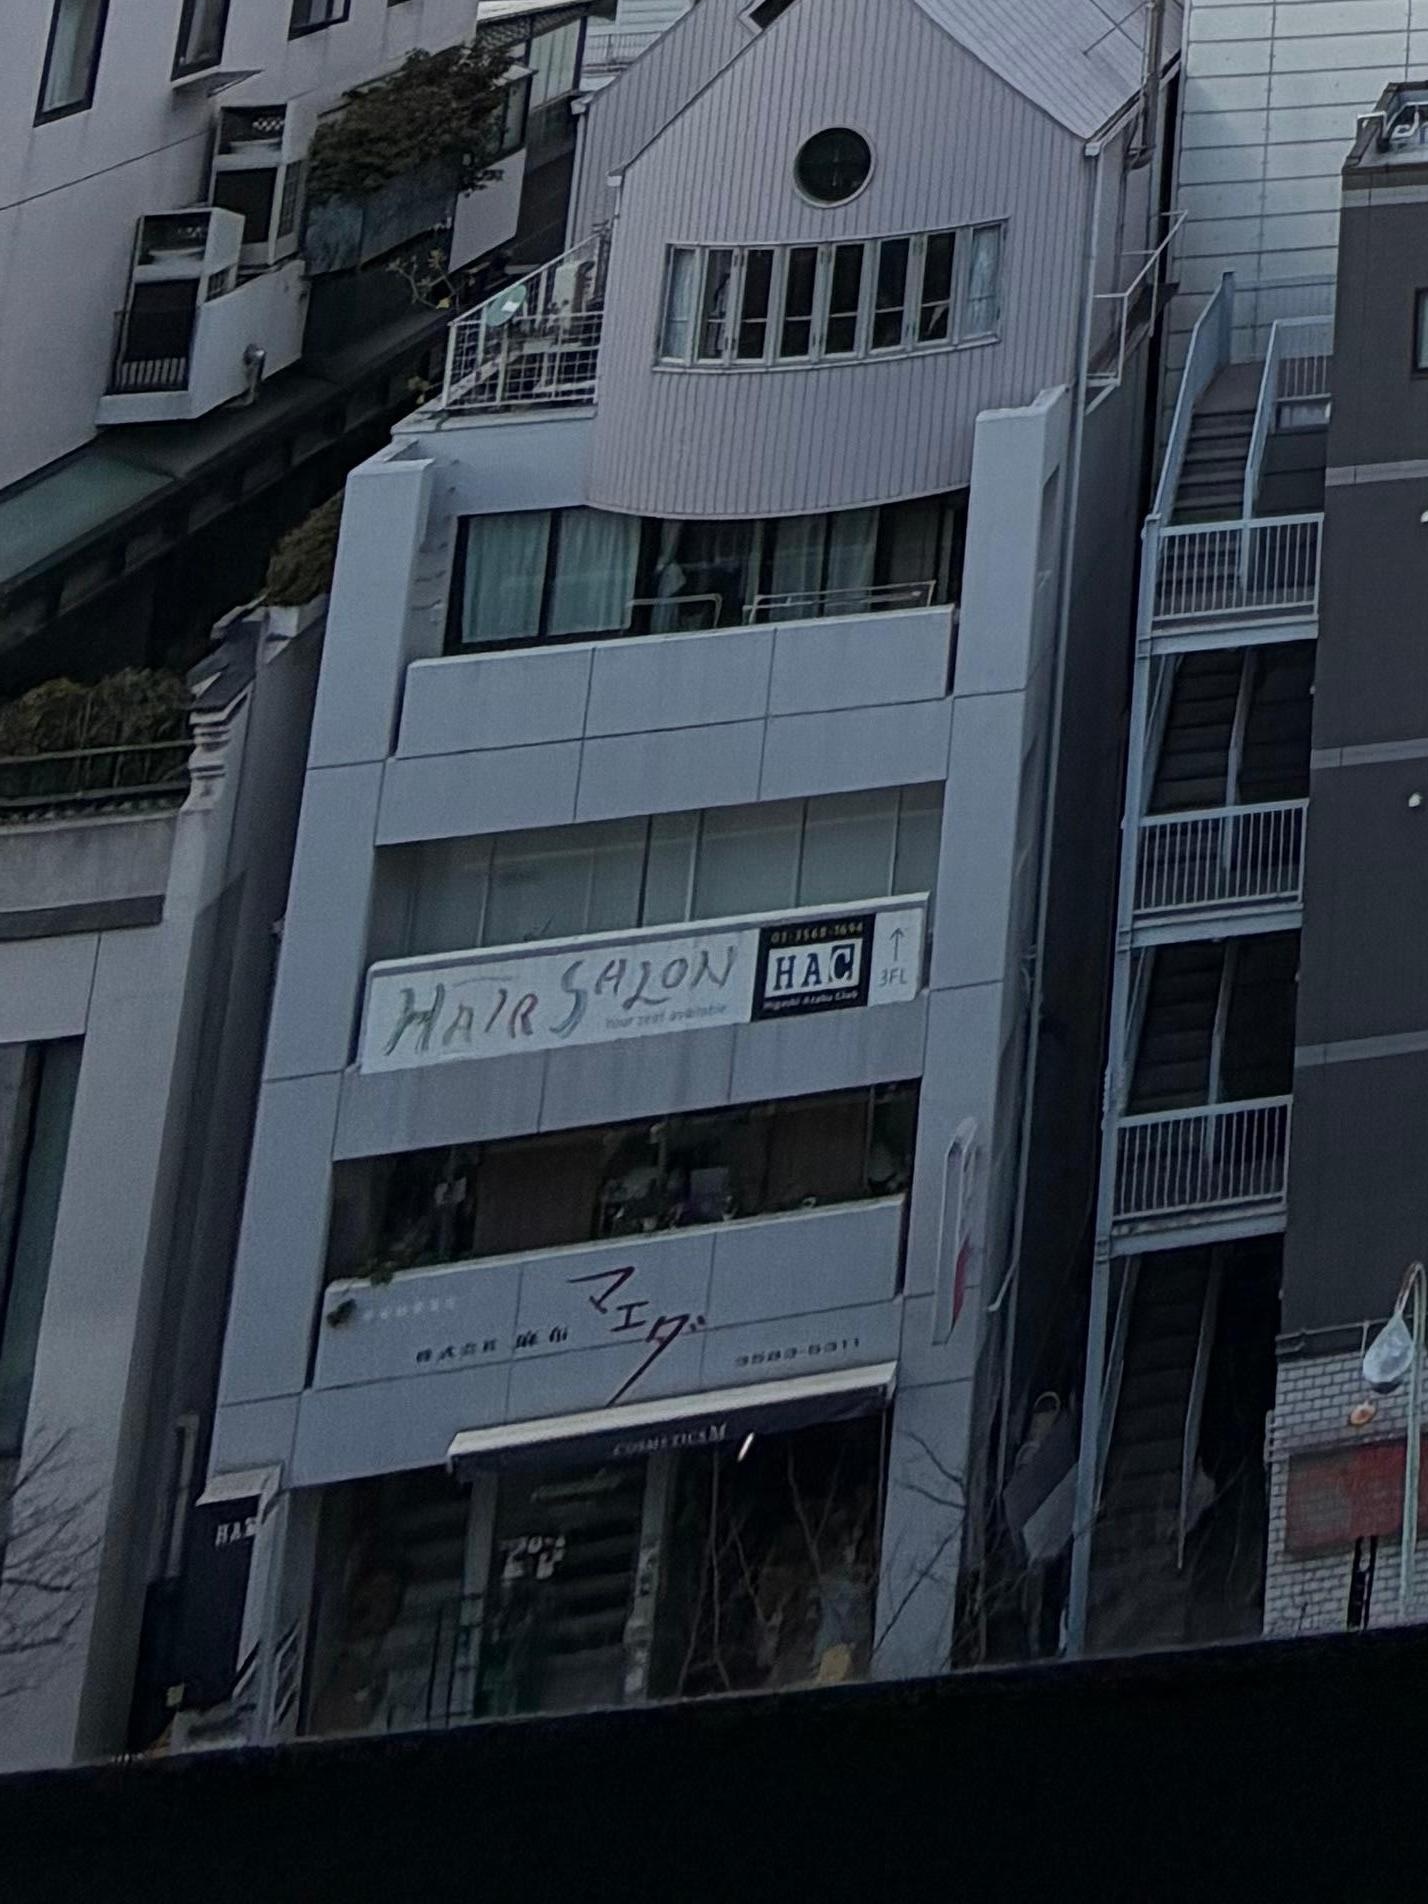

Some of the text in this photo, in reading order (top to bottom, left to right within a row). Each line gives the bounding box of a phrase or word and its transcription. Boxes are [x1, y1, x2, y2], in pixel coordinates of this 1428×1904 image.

[384, 945, 739, 1056] HAIR SALON
[773, 944, 855, 992] HAC
[568, 1266, 708, 1408] マエダ
